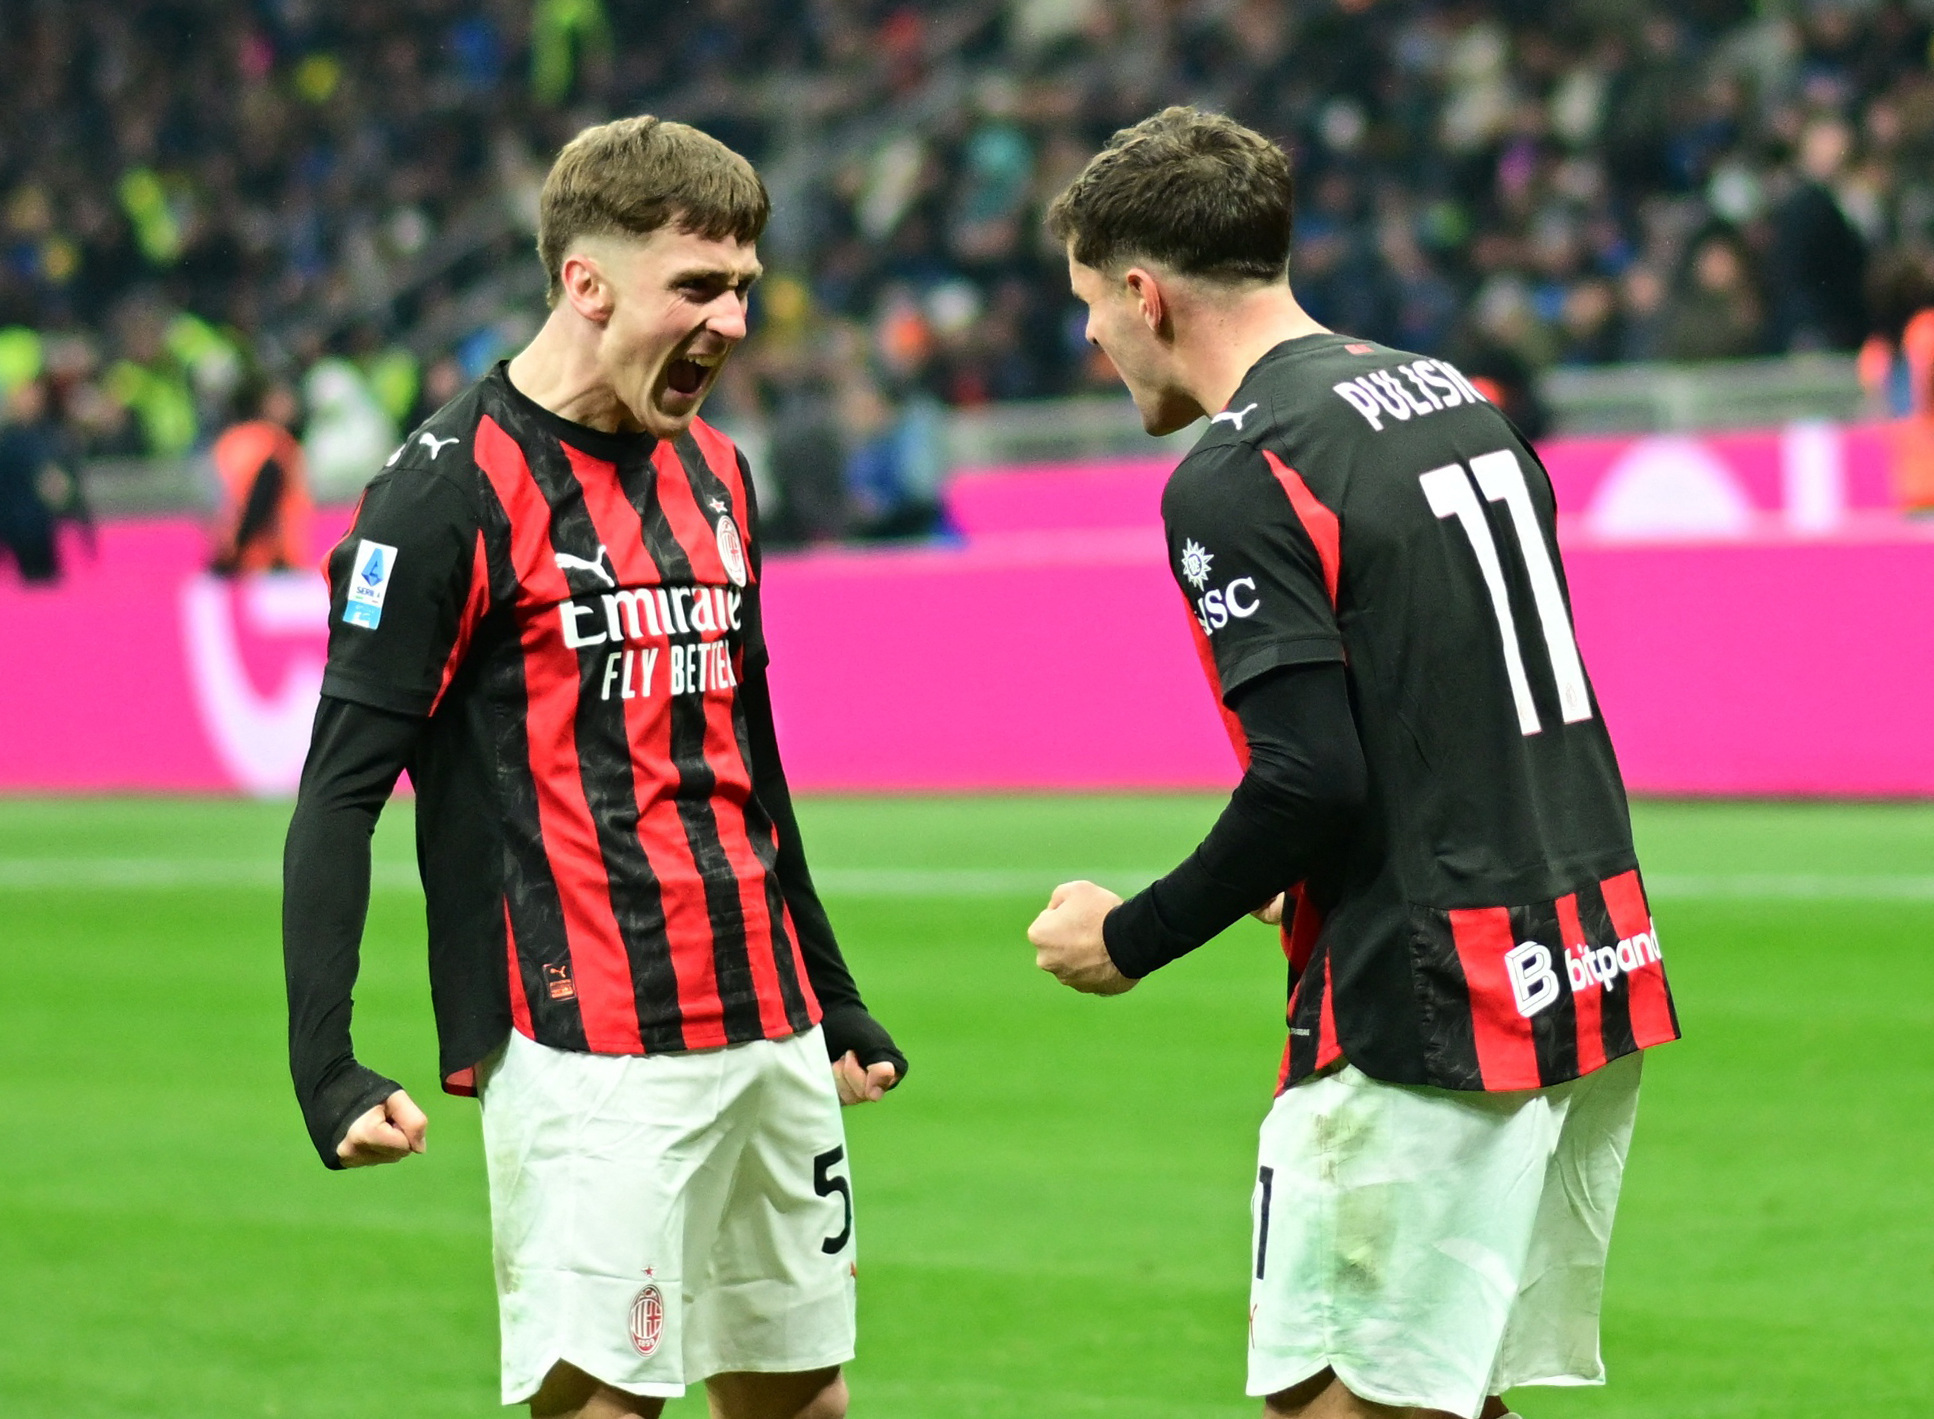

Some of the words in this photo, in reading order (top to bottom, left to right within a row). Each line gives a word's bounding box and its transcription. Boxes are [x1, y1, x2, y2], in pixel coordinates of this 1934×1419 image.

[1332, 358, 1488, 432] PULISI
[1419, 449, 1592, 736] 11
[601, 647, 659, 701] FLY
[814, 1143, 852, 1255] 5
